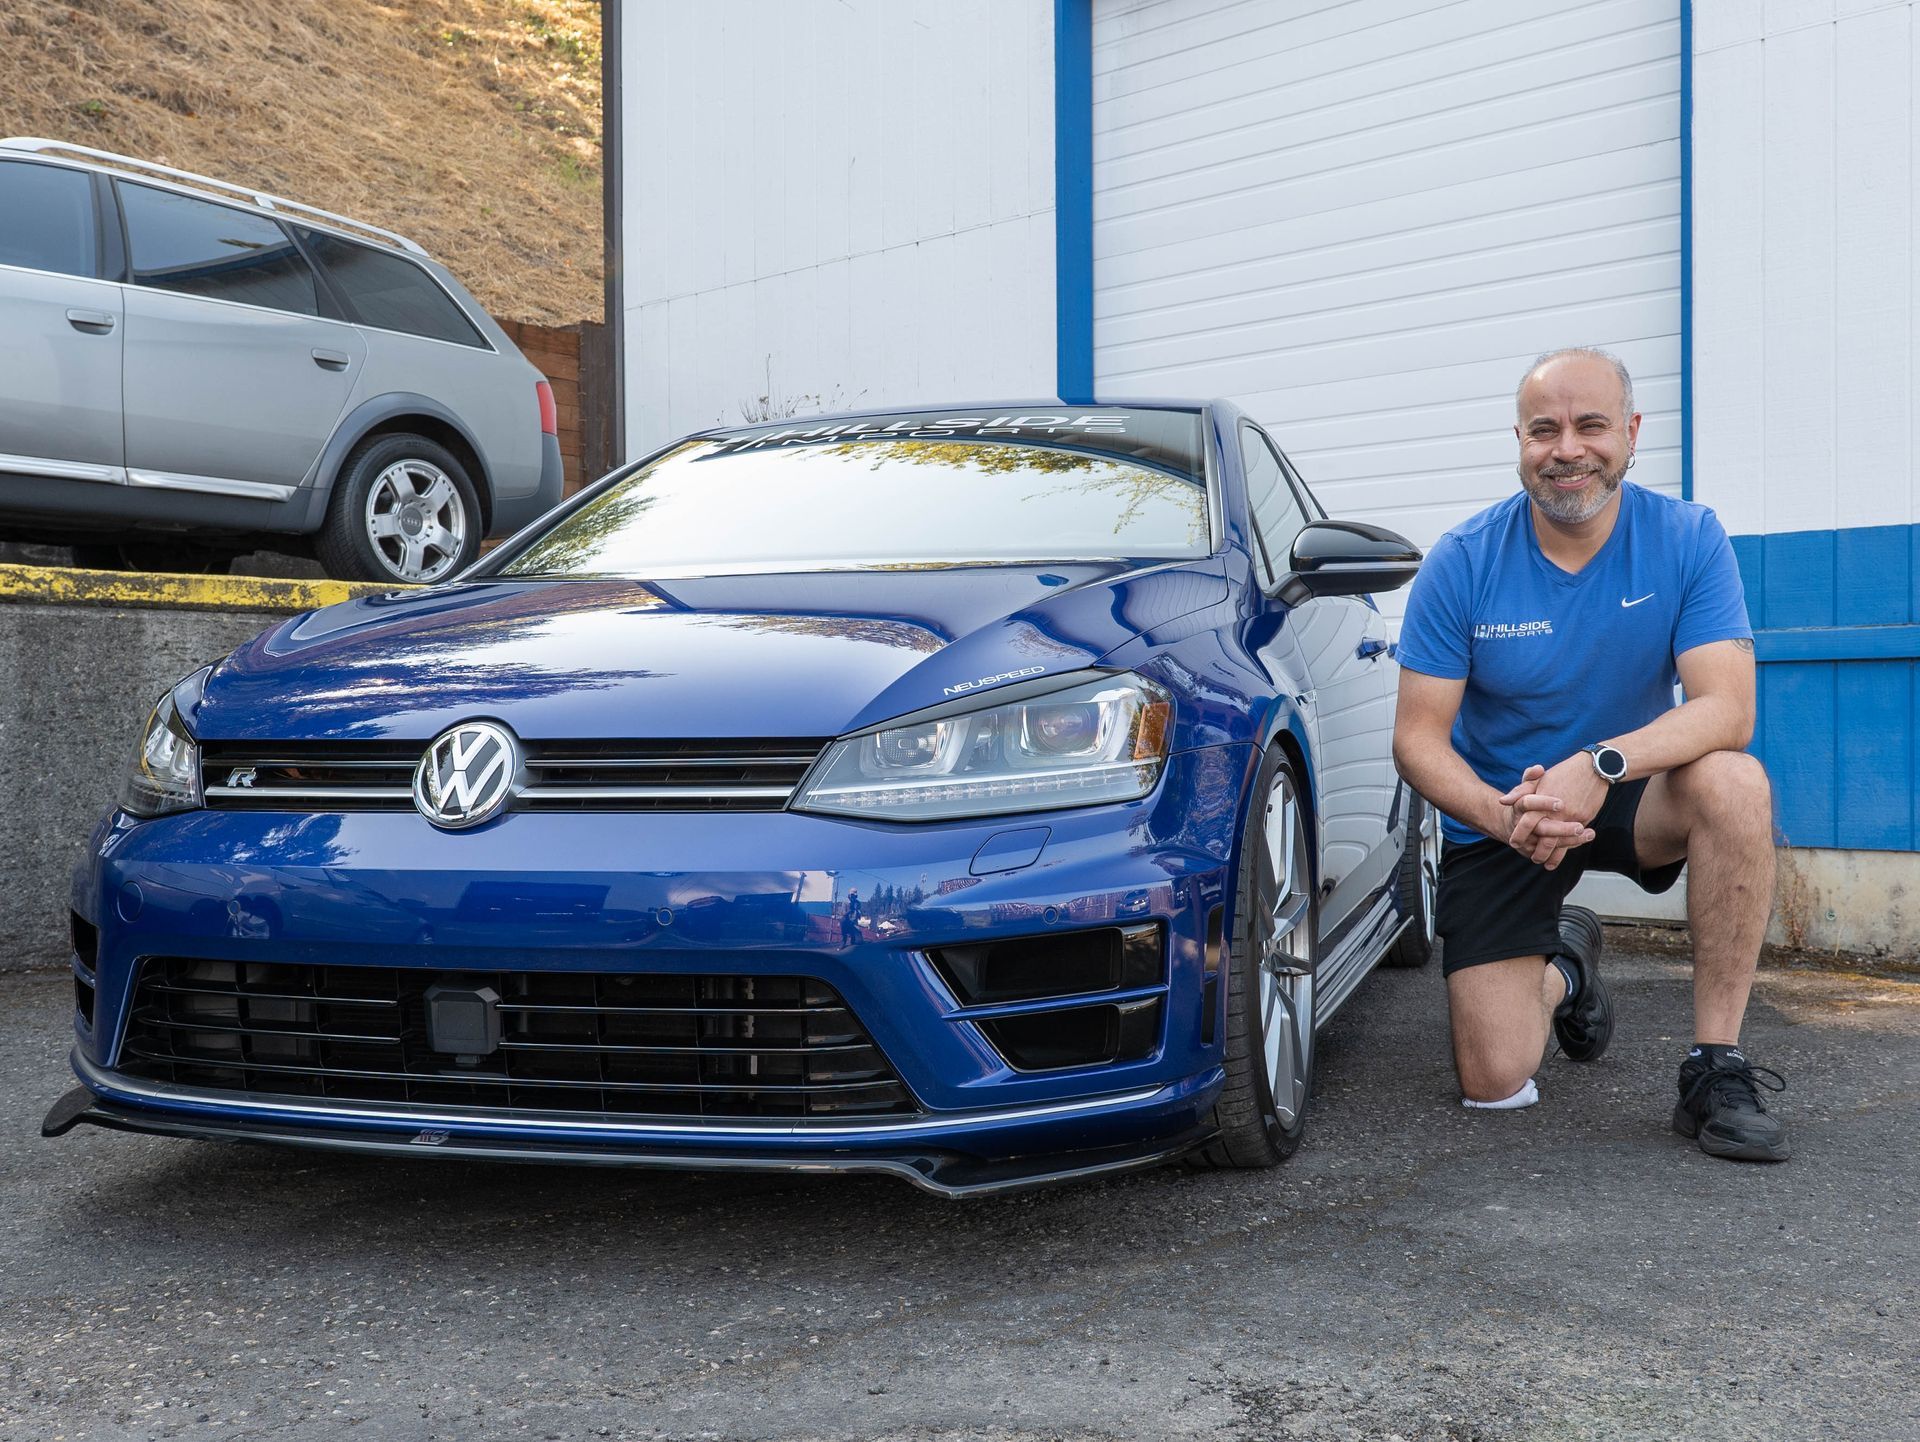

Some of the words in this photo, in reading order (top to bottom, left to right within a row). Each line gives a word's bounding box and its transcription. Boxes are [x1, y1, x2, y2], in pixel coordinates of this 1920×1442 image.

[755, 427, 1127, 449] IMPORTS
[767, 415, 1131, 441] HILLSIDE
[1490, 628, 1554, 639] IMPORTS
[1491, 620, 1552, 633] HILLSIDE
[943, 665, 1046, 696] NEUSPEED
[226, 767, 257, 788] R
